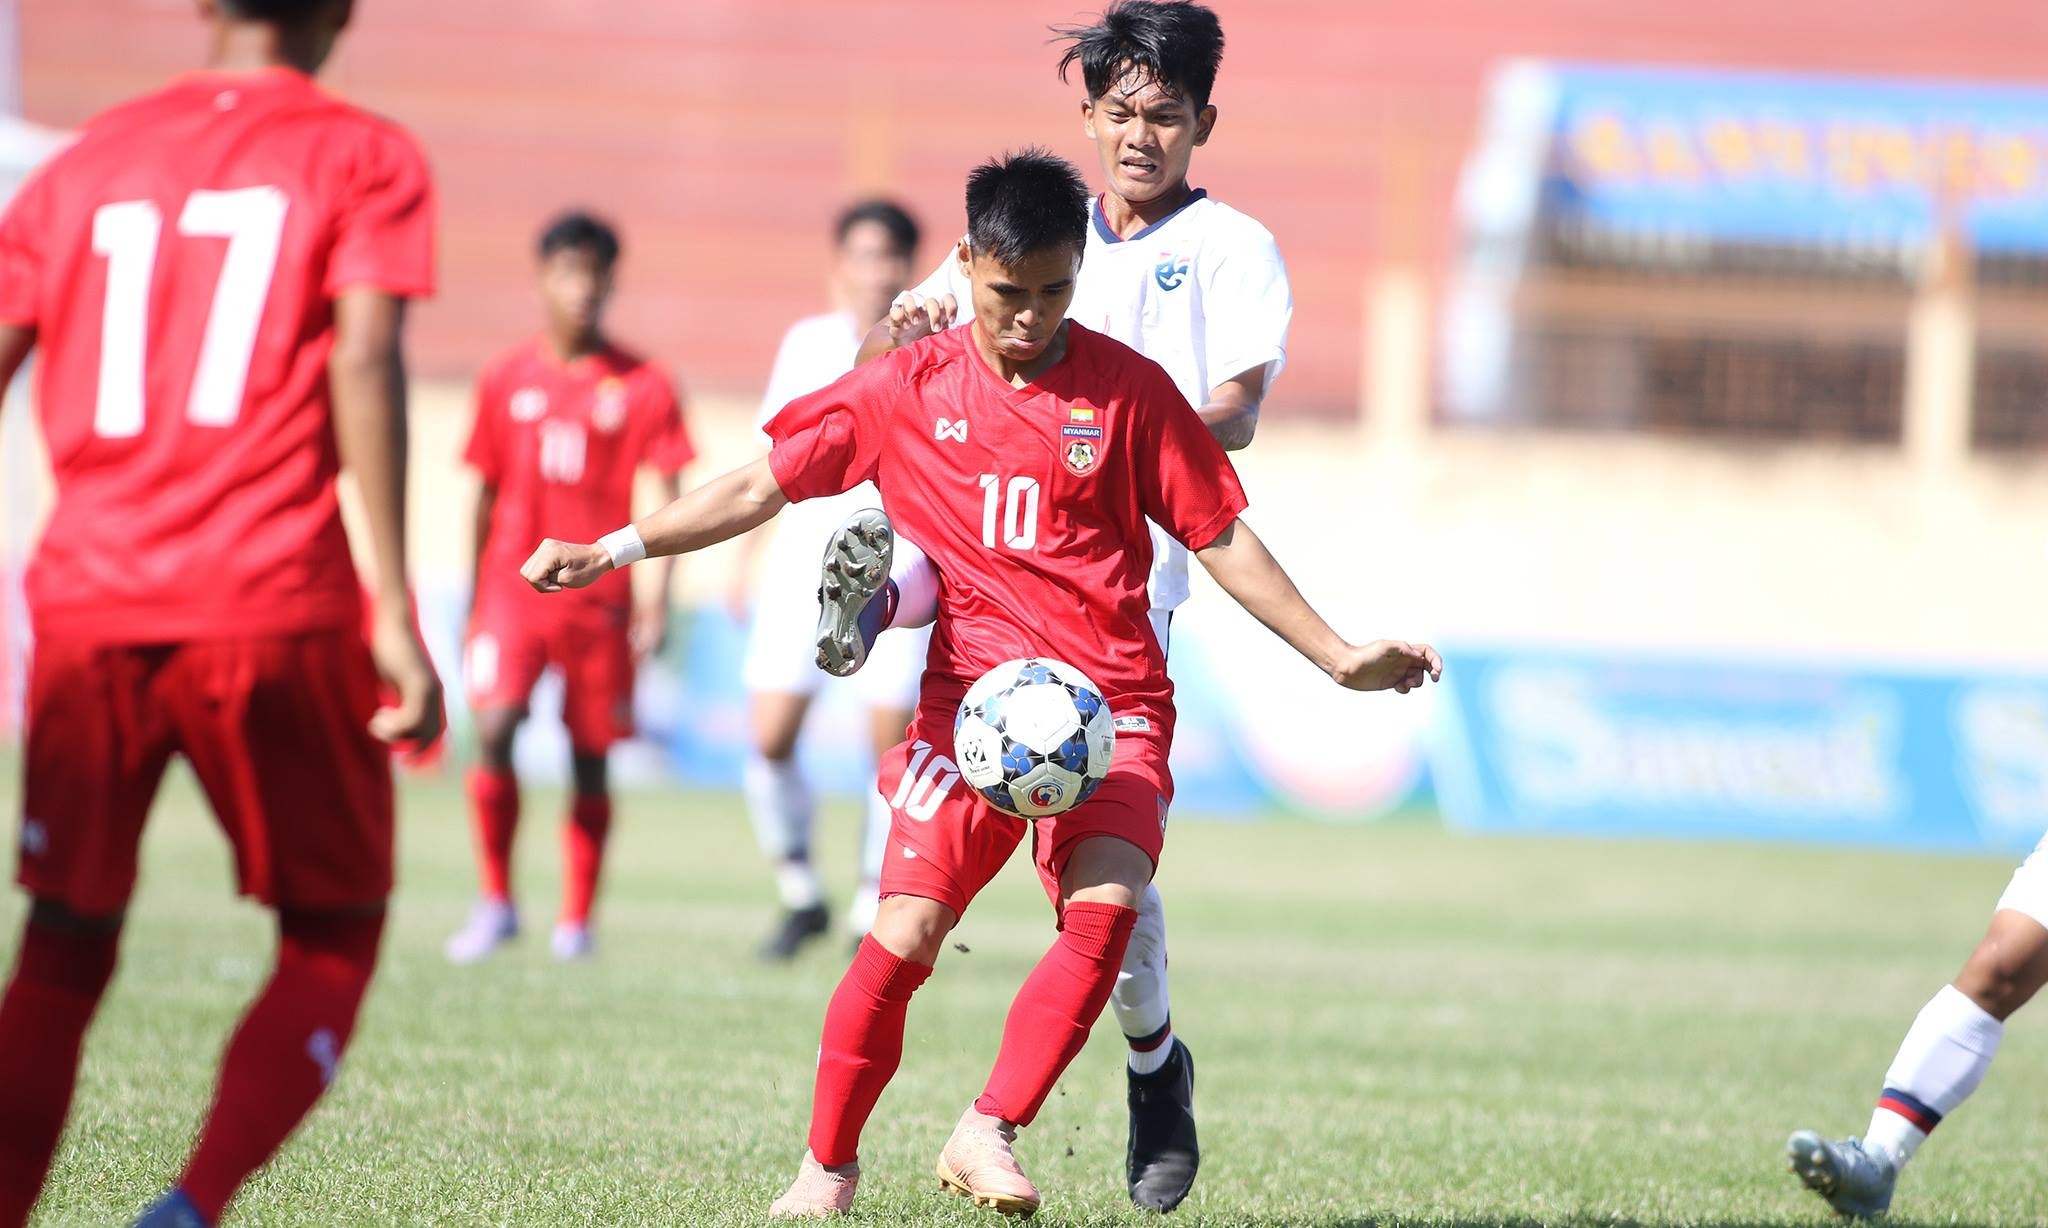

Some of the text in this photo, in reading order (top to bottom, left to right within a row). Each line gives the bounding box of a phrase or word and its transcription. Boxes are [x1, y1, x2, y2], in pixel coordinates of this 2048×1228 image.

[91, 184, 290, 439] 17
[1063, 427, 1100, 437] MYANMAR
[979, 473, 1040, 550] 10
[889, 739, 961, 822] 10
